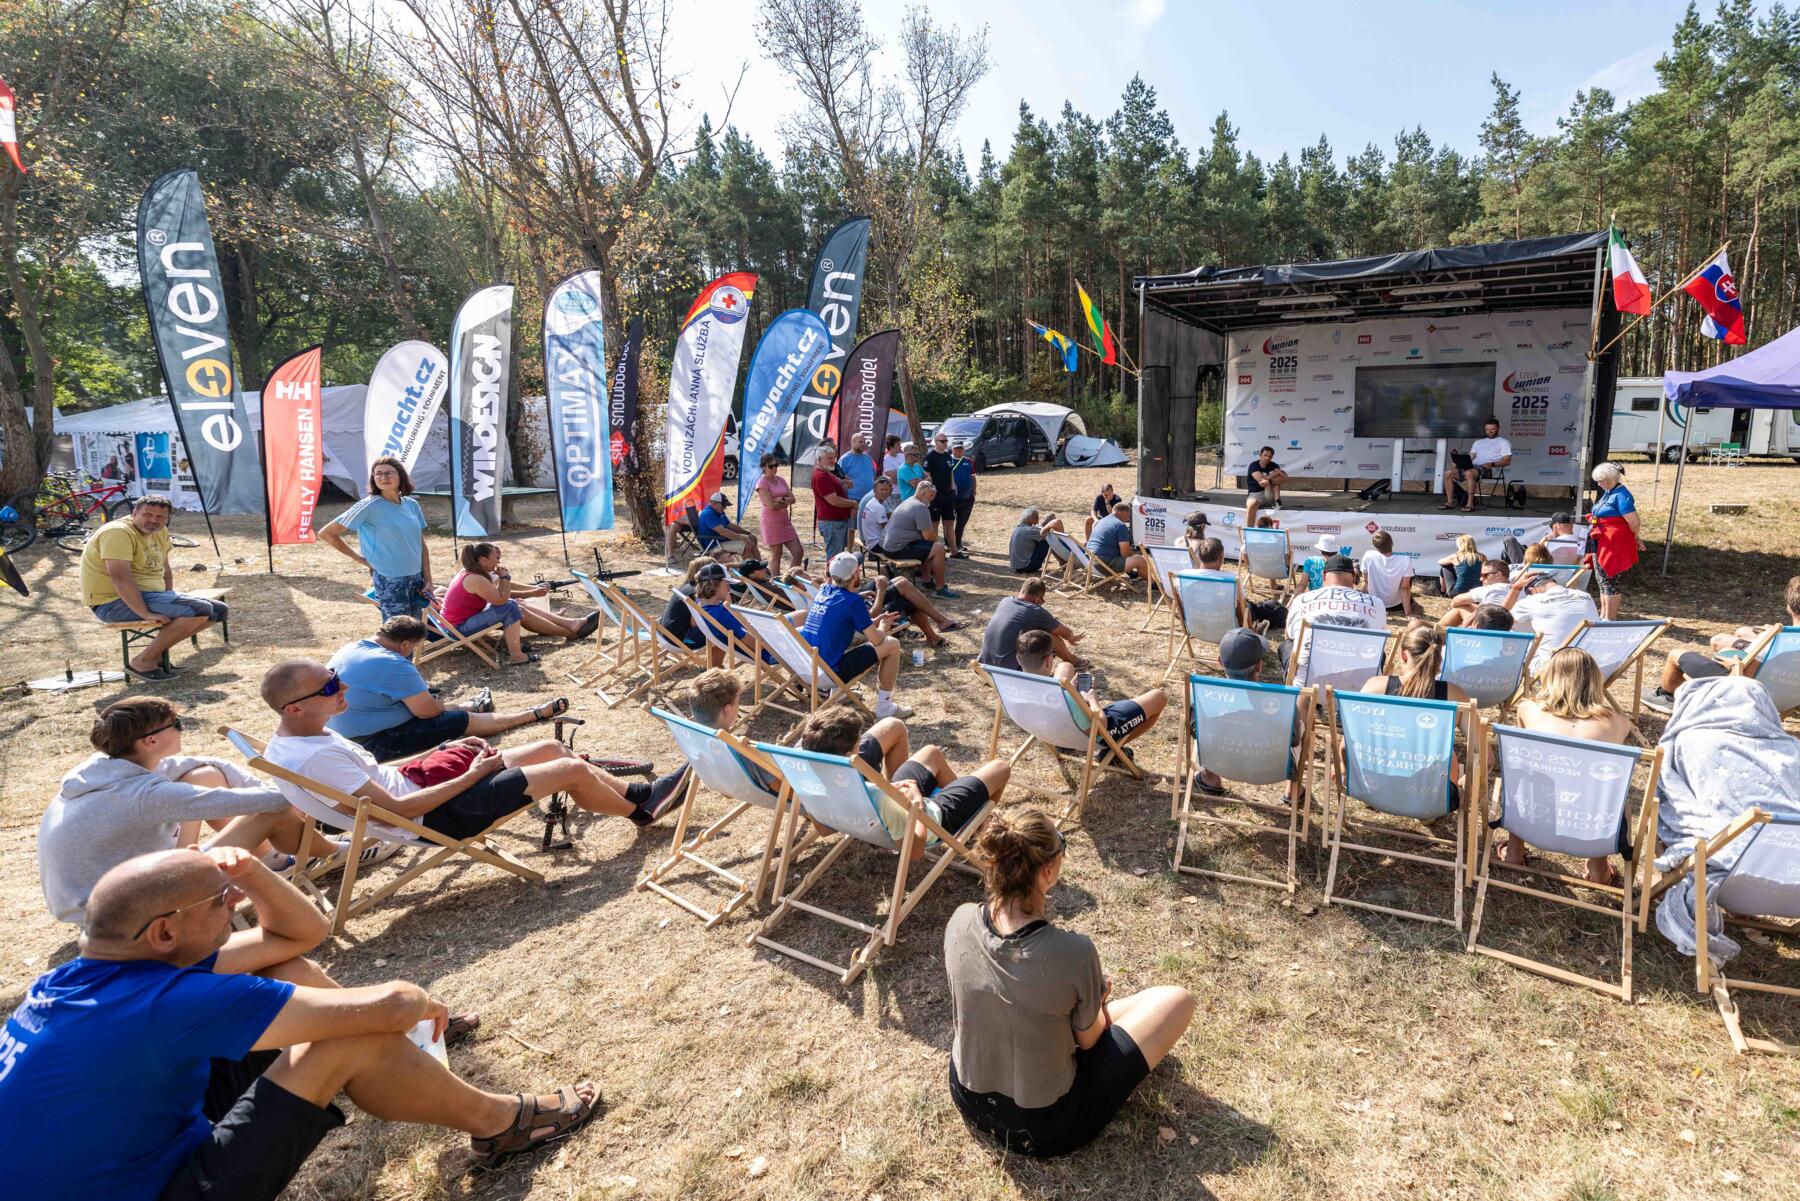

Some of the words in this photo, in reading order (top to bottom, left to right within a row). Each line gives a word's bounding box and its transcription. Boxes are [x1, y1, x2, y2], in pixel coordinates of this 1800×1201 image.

[1270, 356, 1297, 368] 2025
[275, 380, 313, 401] HH
[743, 326, 819, 453] oneyacht.cz
[1514, 376, 1551, 389] JUNIOR
[682, 443, 695, 476] VODNÍ
[693, 319, 711, 369] SLUŽBA
[1511, 396, 1549, 408] 2025
[400, 414, 425, 464] WINDSURFING
[423, 369, 447, 411] EQUIPMENT
[472, 333, 502, 502] WINDESIGN
[554, 345, 593, 488] OPTIMAX
[297, 408, 316, 481] HANSEN
[298, 489, 315, 539] HELLY
[1145, 517, 1166, 528] 2025
[1302, 587, 1375, 606] CZECH
[1301, 601, 1377, 619] REPUBLIC
[1120, 714, 1144, 734] HELLY
